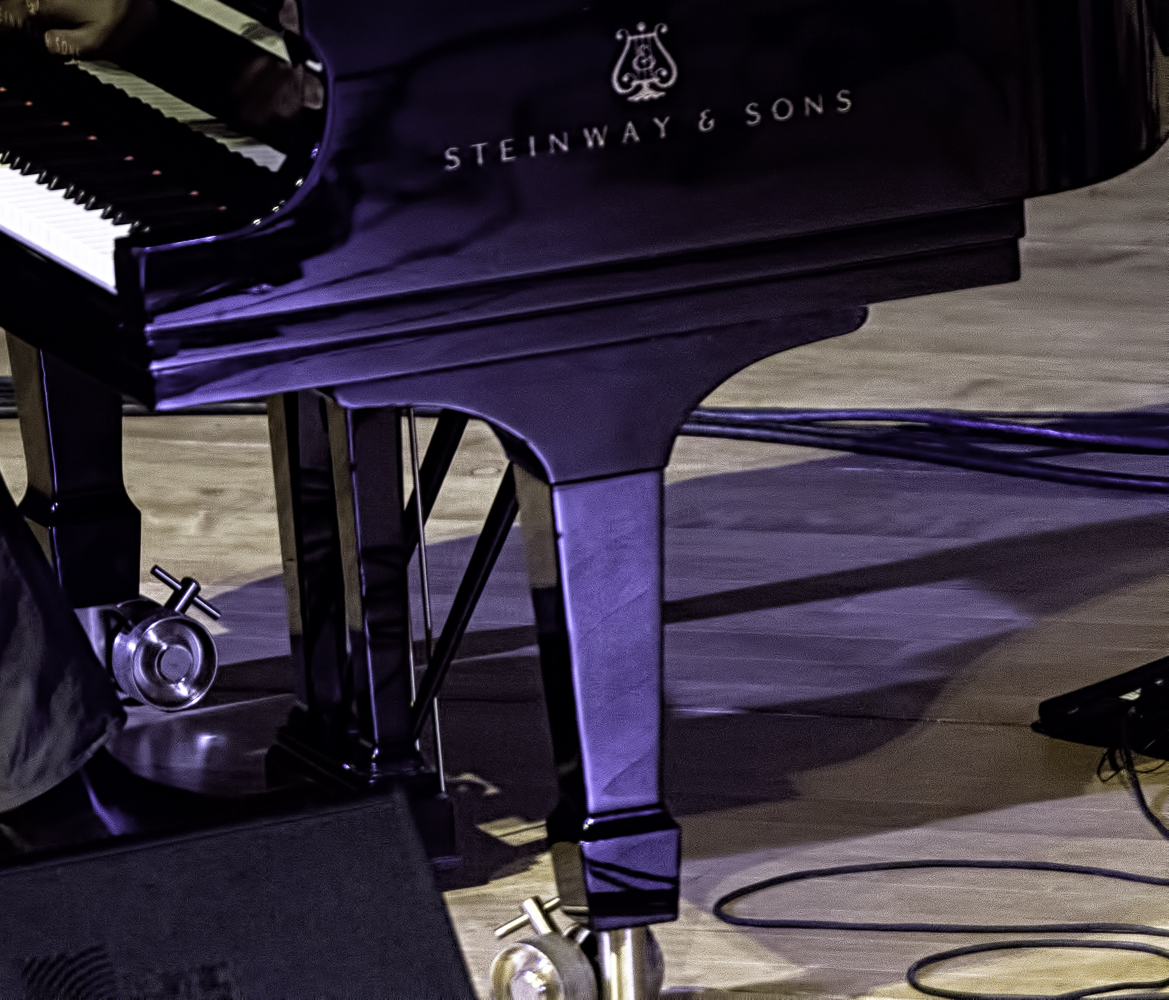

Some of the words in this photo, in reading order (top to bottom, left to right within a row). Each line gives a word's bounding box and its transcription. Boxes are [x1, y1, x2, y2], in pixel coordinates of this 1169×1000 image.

[444, 116, 670, 171] STEINWAY
[698, 109, 715, 132] &
[745, 90, 852, 126] SONS
